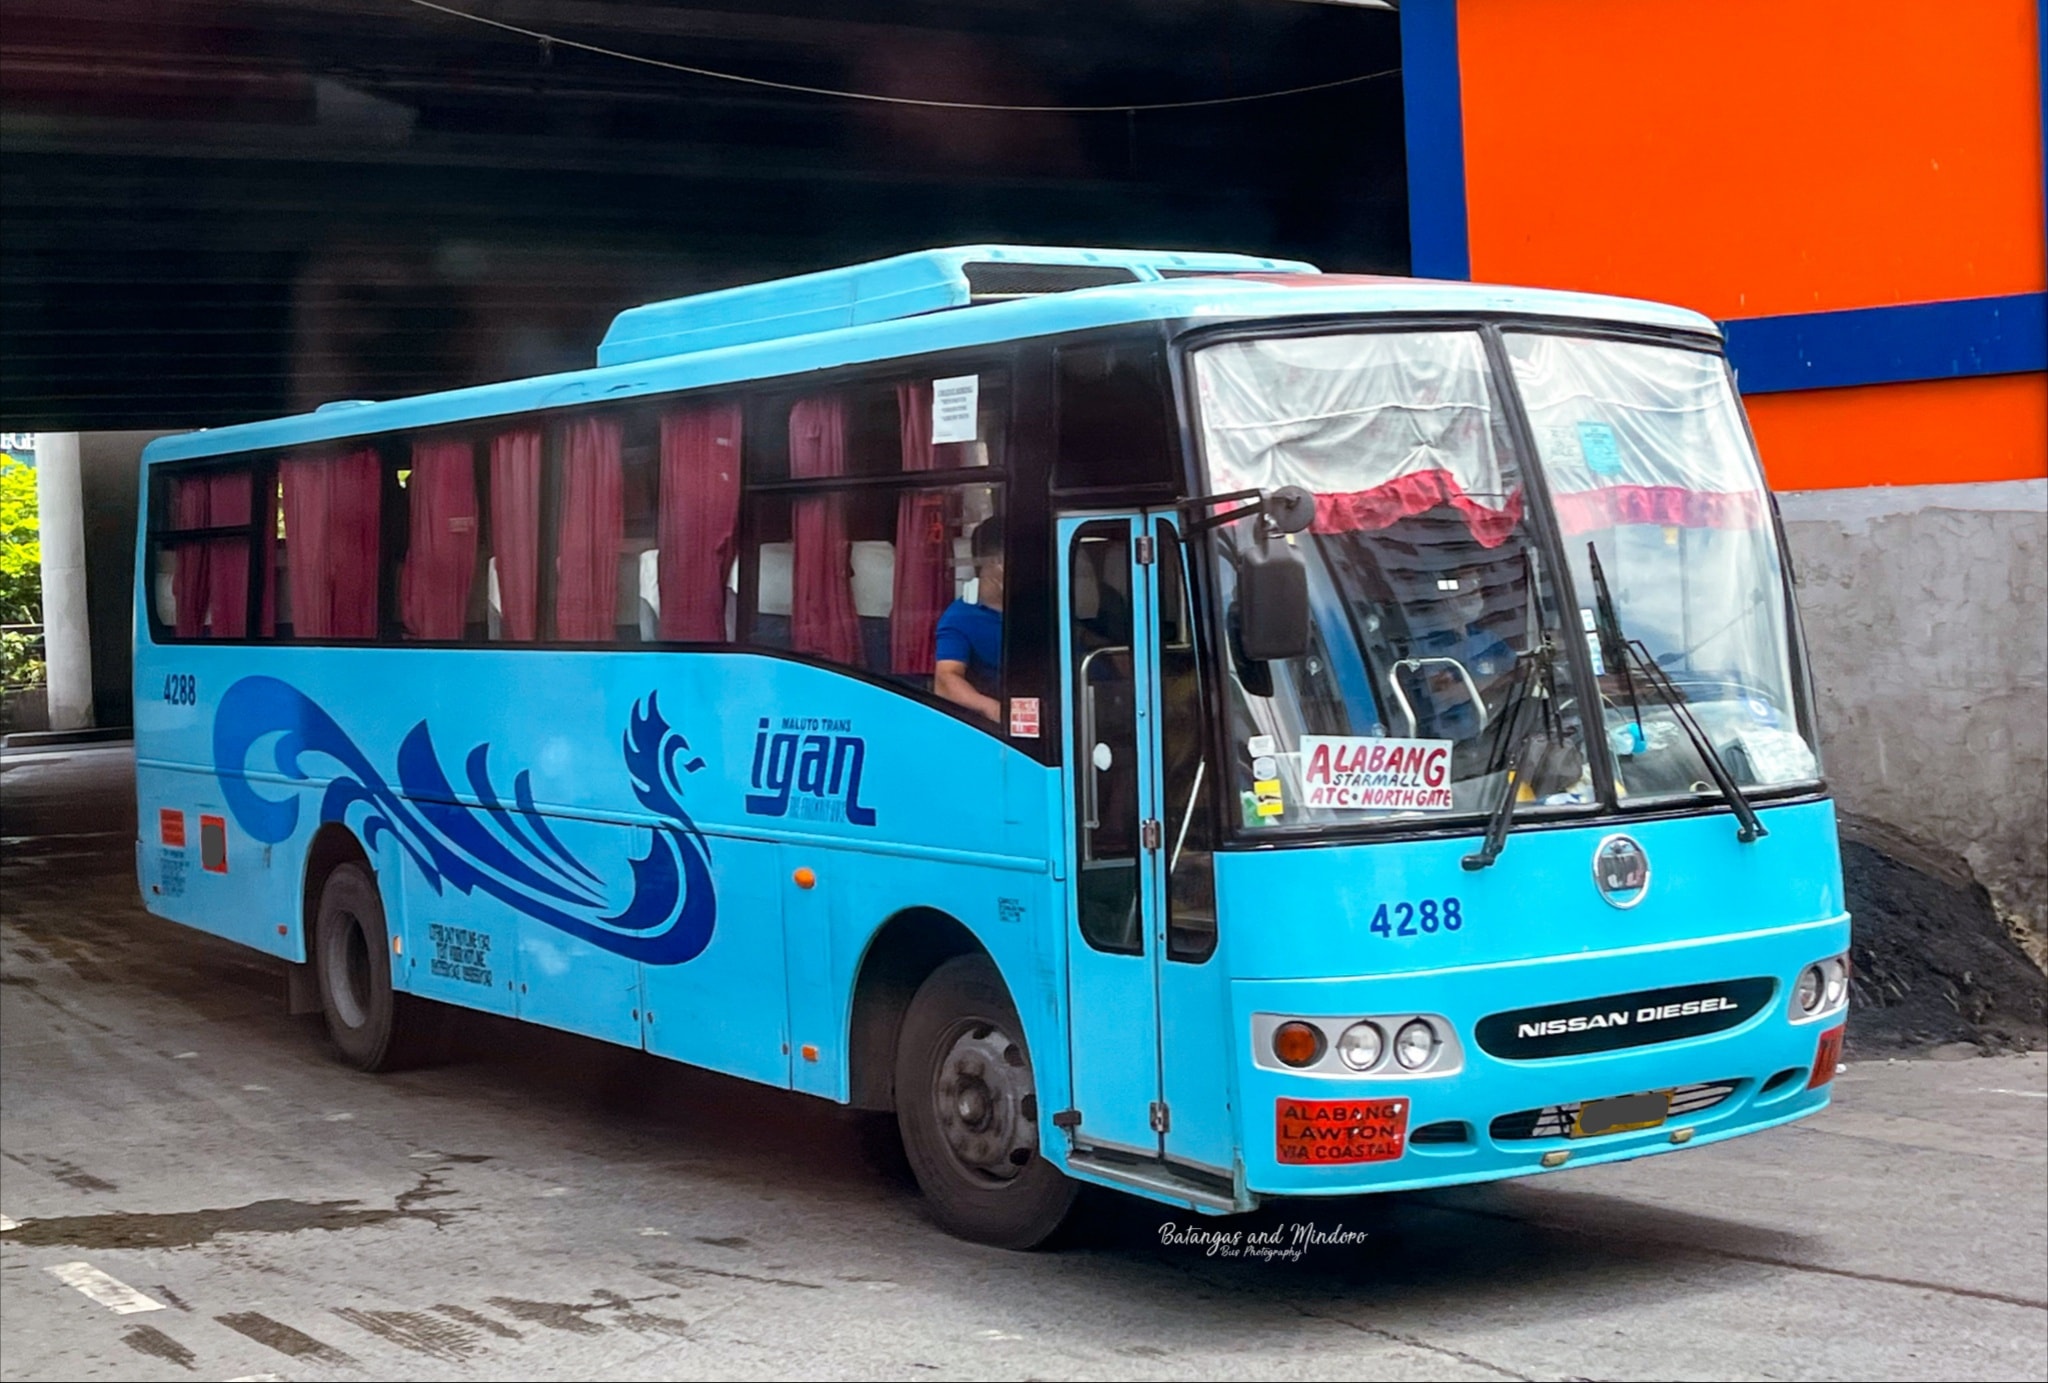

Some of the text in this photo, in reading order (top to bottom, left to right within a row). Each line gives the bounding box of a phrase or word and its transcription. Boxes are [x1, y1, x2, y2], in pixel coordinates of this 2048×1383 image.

[163, 673, 196, 706] 4288
[782, 717, 851, 732] MALUTO TRANS
[1306, 743, 1447, 788] ALABANG
[1332, 773, 1421, 787] STARMALL
[1310, 788, 1349, 805] ATC
[1369, 897, 1462, 938] 4288
[1518, 997, 1738, 1038] NISSAN DIESEL
[1284, 1106, 1398, 1121] ALABANG
[1283, 1125, 1396, 1140] LAWTON
[1280, 1142, 1396, 1160] VIA COASTAL
